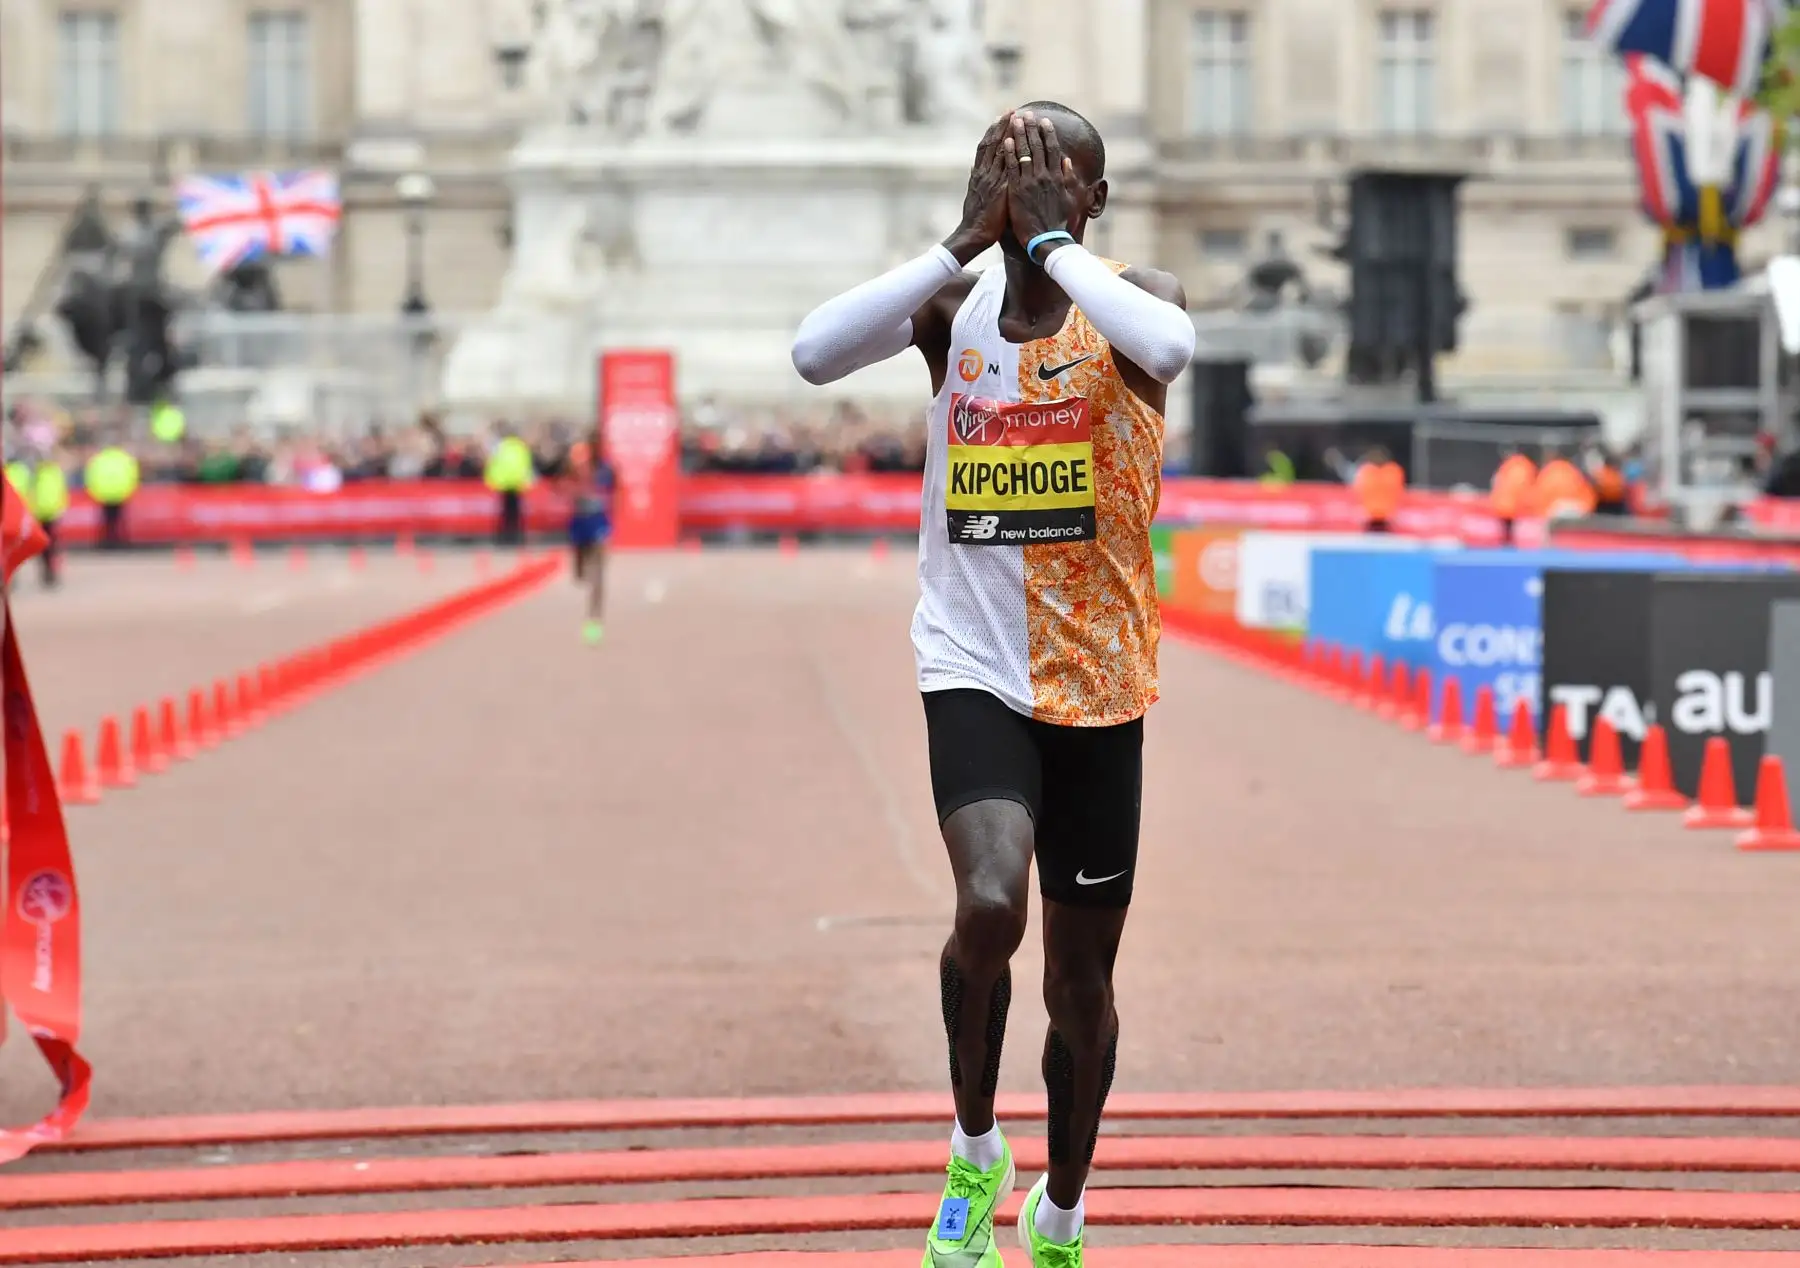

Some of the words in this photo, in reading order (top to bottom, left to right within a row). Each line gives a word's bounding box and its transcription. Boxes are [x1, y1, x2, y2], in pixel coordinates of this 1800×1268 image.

[988, 363, 1001, 376] N
[1006, 408, 1083, 429] money
[951, 459, 1088, 496] KIPCHOGE
[1001, 529, 1027, 540] new
[1029, 525, 1083, 539] balance
[1549, 684, 1657, 741] TA
